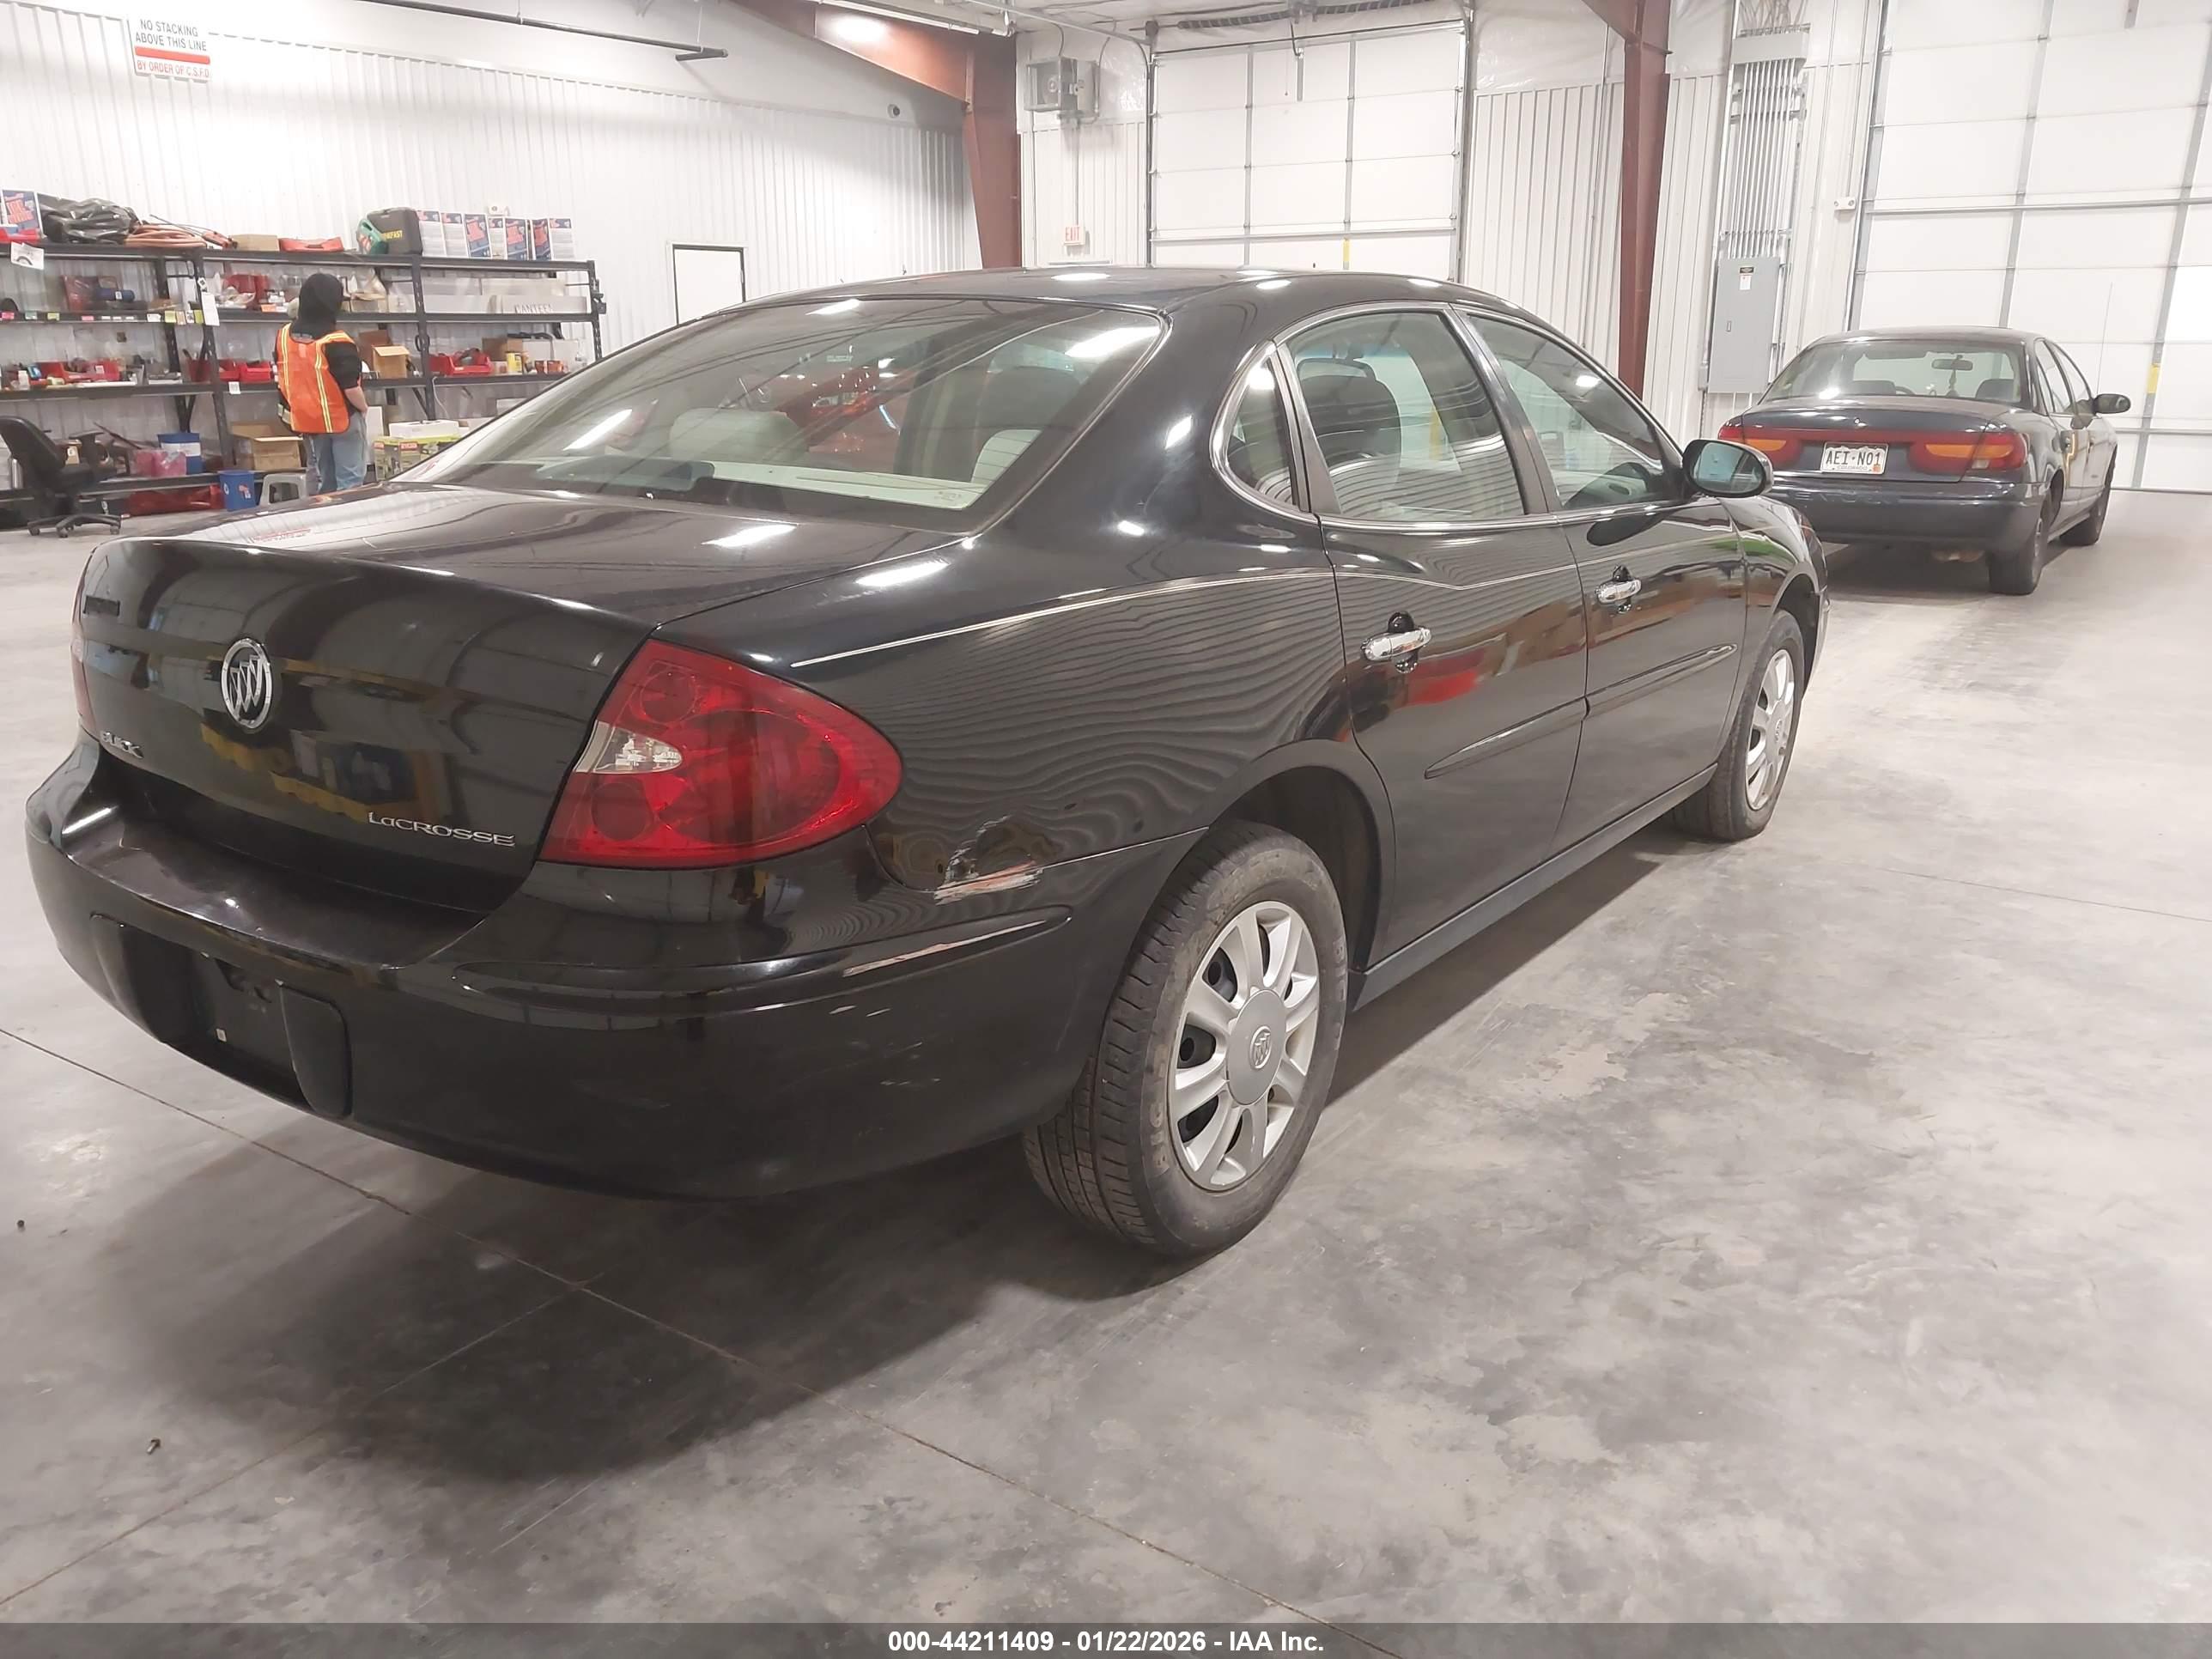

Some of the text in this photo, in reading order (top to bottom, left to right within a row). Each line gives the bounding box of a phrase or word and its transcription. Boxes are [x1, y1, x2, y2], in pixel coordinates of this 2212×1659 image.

[140, 19, 198, 37] NO STACKING
[136, 32, 207, 52] ABOVE THIS LINE
[137, 59, 147, 70] BY
[149, 61, 173, 75] ORDER
[174, 64, 185, 75] OF
[1065, 226, 1080, 241] EXIT
